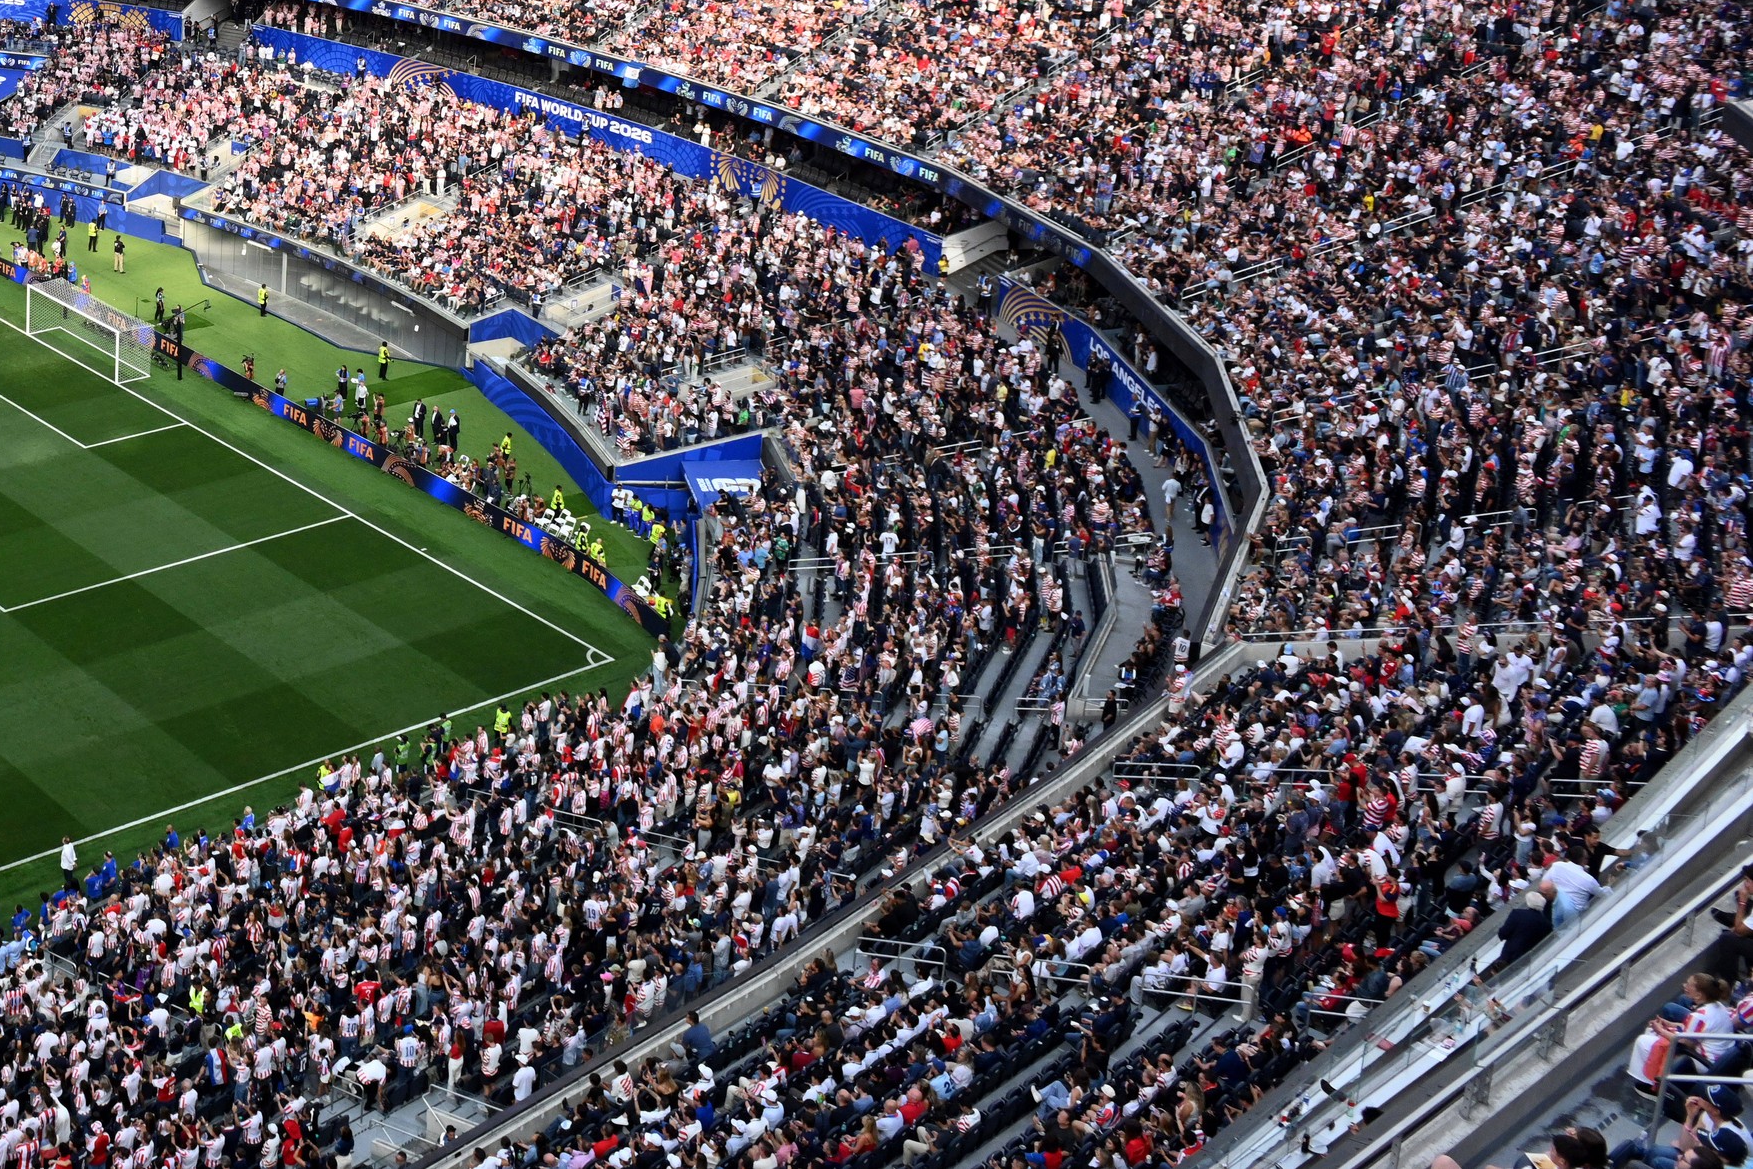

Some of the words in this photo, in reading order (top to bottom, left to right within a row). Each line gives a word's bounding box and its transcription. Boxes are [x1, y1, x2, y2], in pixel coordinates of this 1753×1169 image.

[398, 7, 415, 20] FIFA
[443, 19, 461, 31] FIFA
[548, 45, 566, 59] FIFA
[595, 58, 614, 72] FIFA
[702, 90, 722, 105] FIFA
[514, 91, 540, 109] FIFA
[540, 98, 583, 122] WORLD
[609, 120, 653, 144] 2026
[752, 106, 773, 122] FIFA
[864, 147, 885, 163] FIFA
[918, 167, 939, 182] FIFA
[59, 182, 72, 191] FIFA
[282, 402, 308, 426] FIFA
[347, 436, 375, 461] FIFA
[502, 514, 534, 545] FIFA
[885, 537, 893, 545] 17
[580, 560, 607, 590] FIFA
[1178, 643, 1187, 653] 10
[587, 907, 596, 920] 19
[649, 906, 661, 915] 10
[347, 1022, 357, 1033] 10
[405, 1045, 415, 1057] 10
